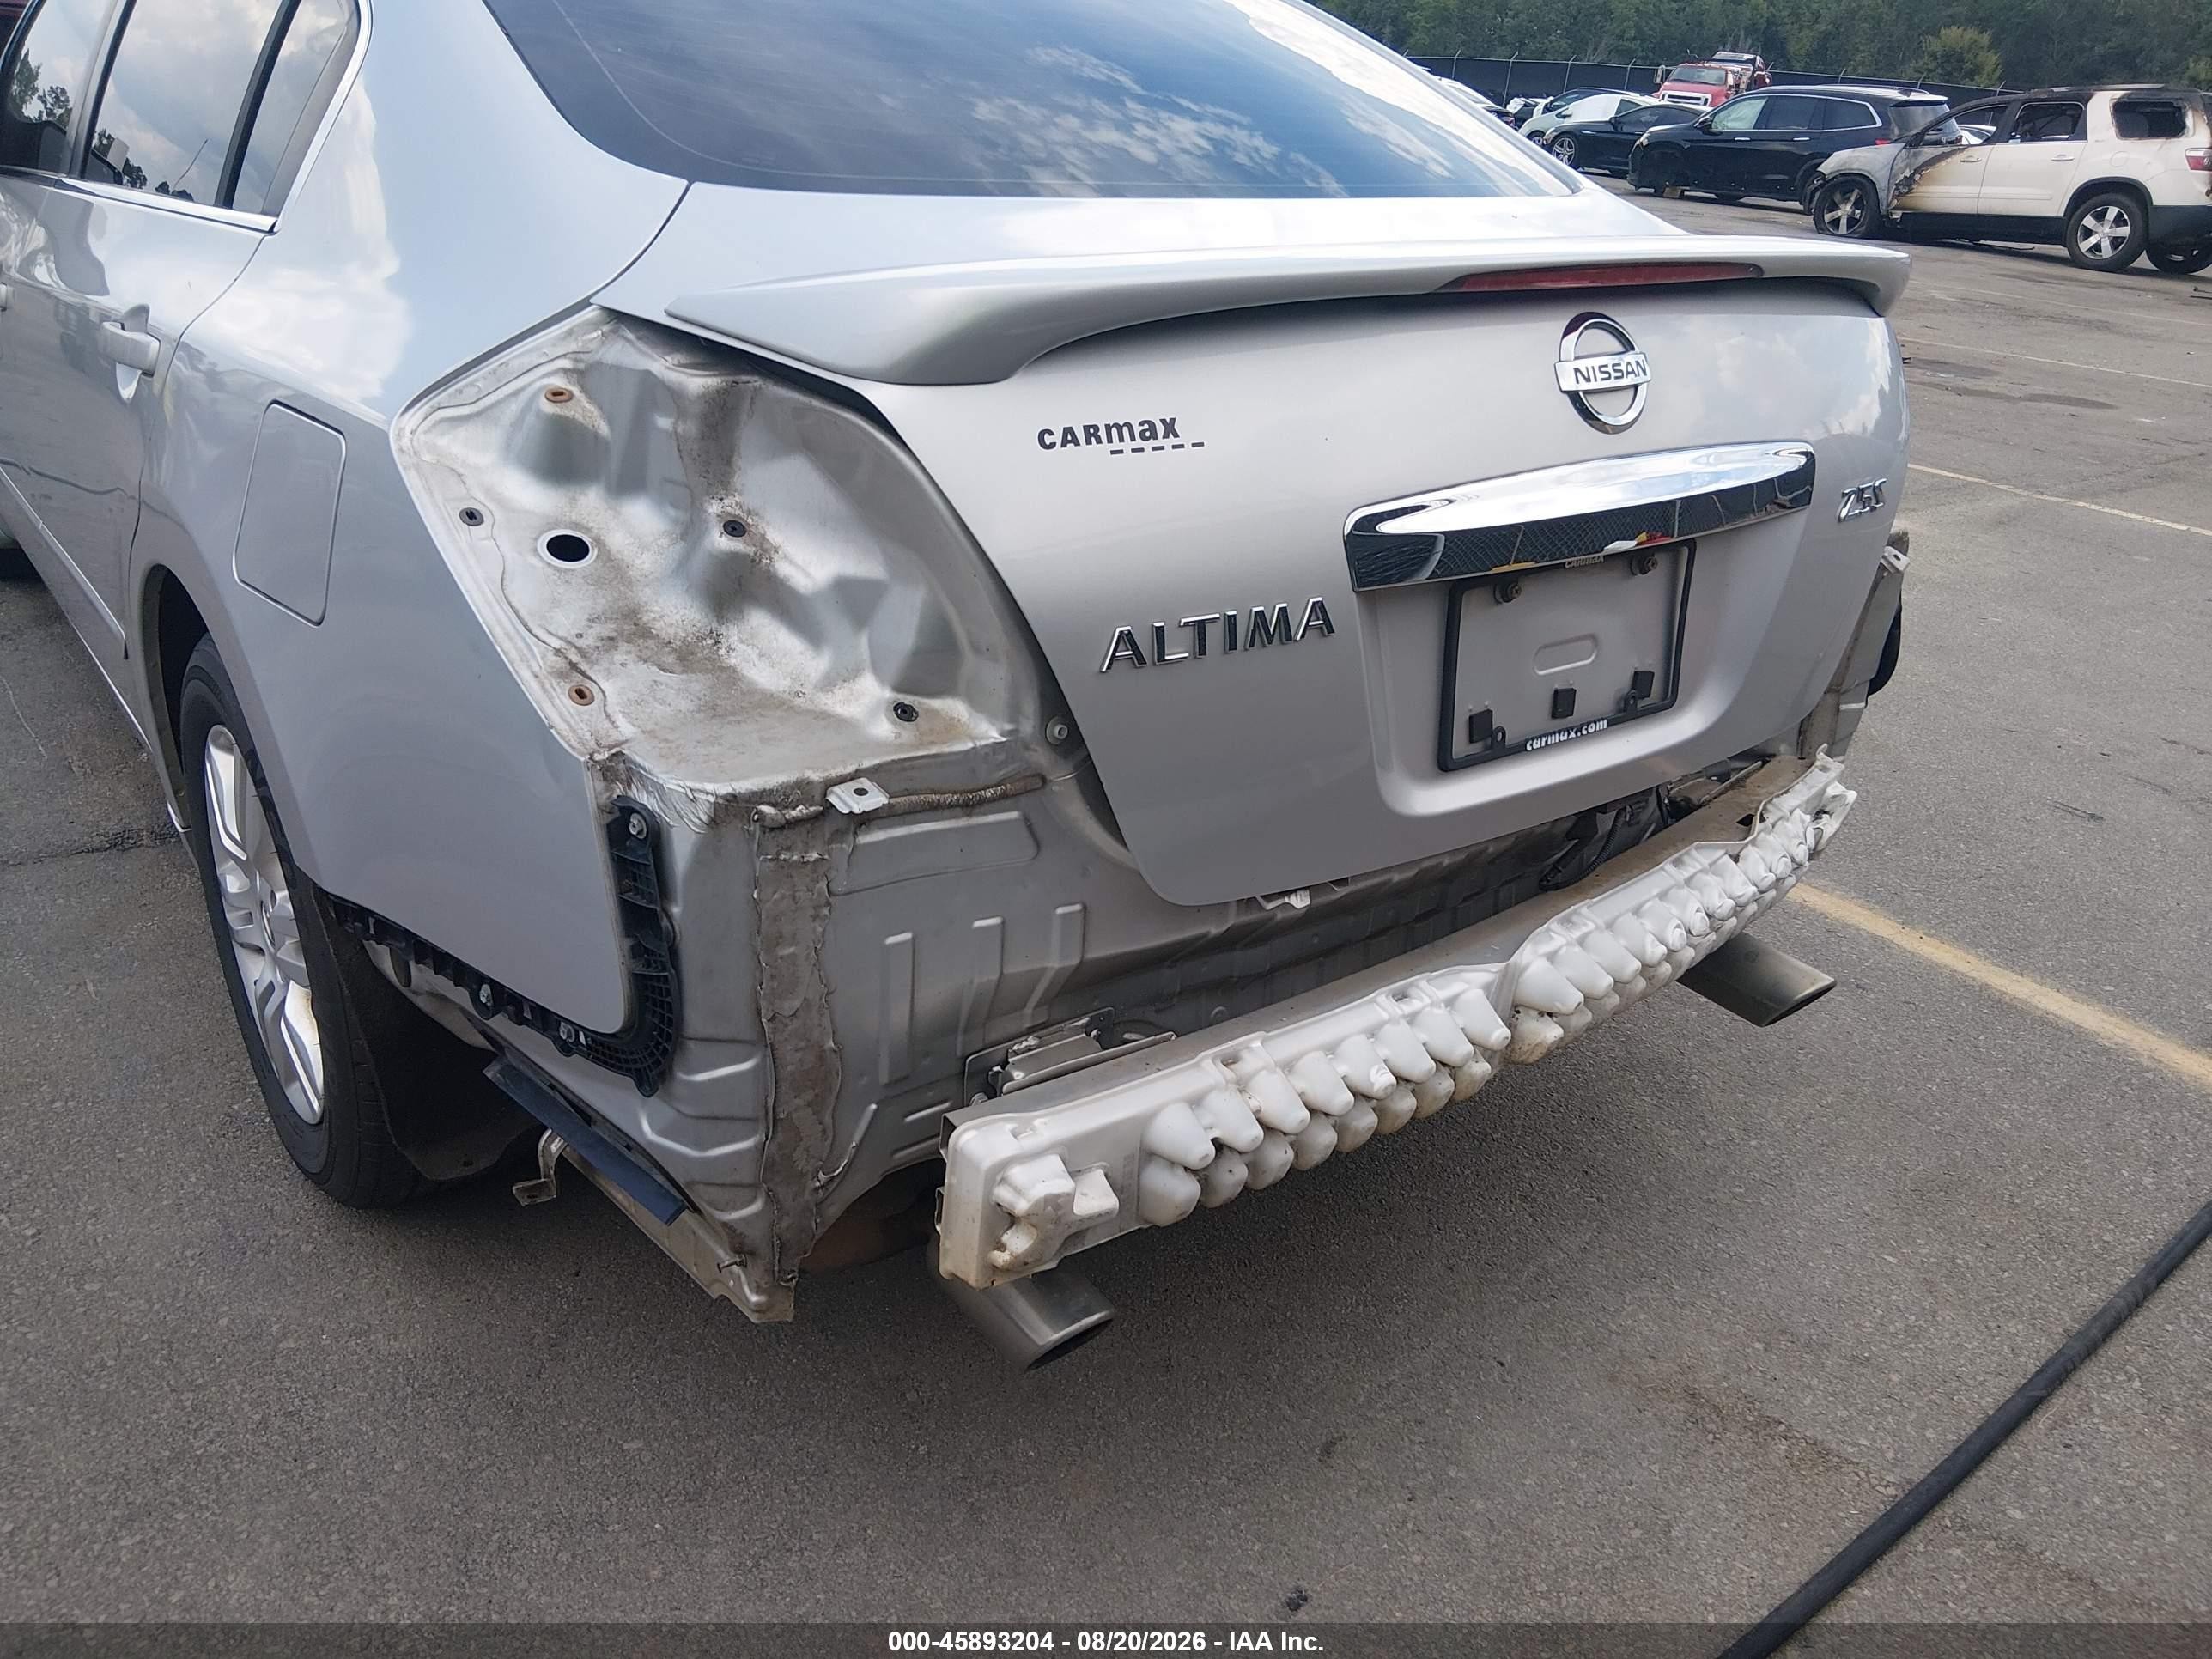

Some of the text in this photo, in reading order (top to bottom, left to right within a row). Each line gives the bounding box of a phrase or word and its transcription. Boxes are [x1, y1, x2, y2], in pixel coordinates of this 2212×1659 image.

[1572, 359, 1648, 385] NISSAN
[1099, 596, 1336, 673] ALTIMA
[1525, 718, 1608, 752] carmax.com
